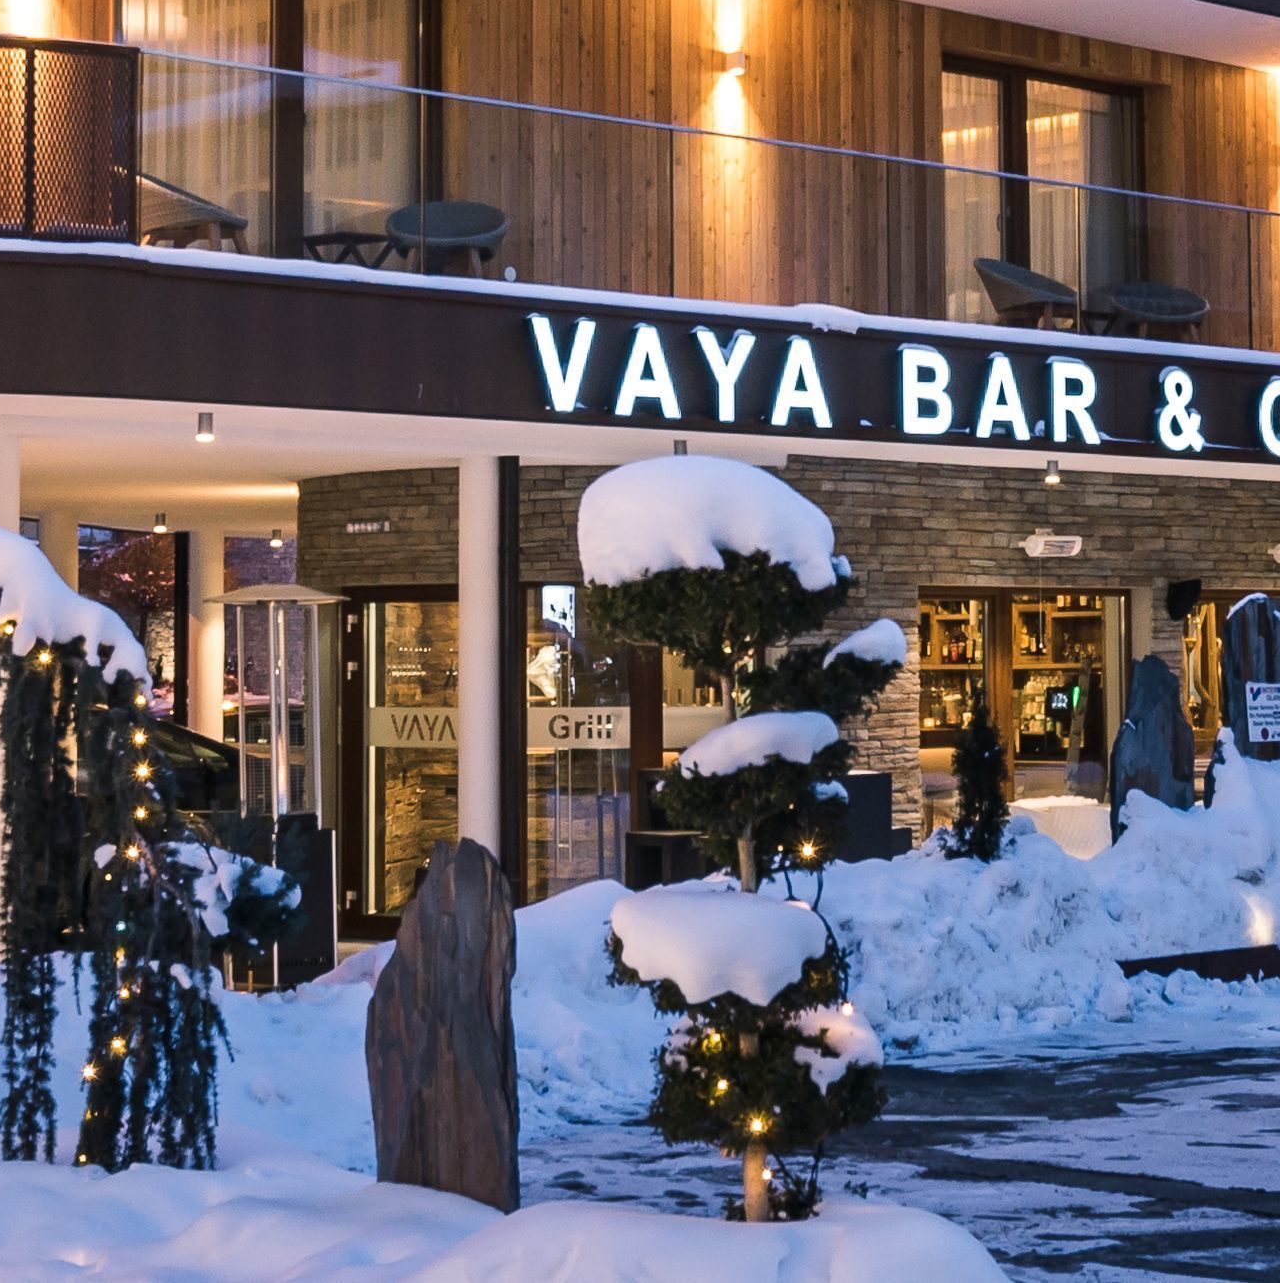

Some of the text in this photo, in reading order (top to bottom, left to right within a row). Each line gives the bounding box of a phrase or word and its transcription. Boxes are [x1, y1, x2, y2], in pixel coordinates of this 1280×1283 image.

[529, 315, 834, 428] VAYA
[900, 347, 1102, 445] BAR
[1157, 369, 1204, 453] &
[391, 714, 457, 742] VAYA
[548, 714, 613, 740] Grill
